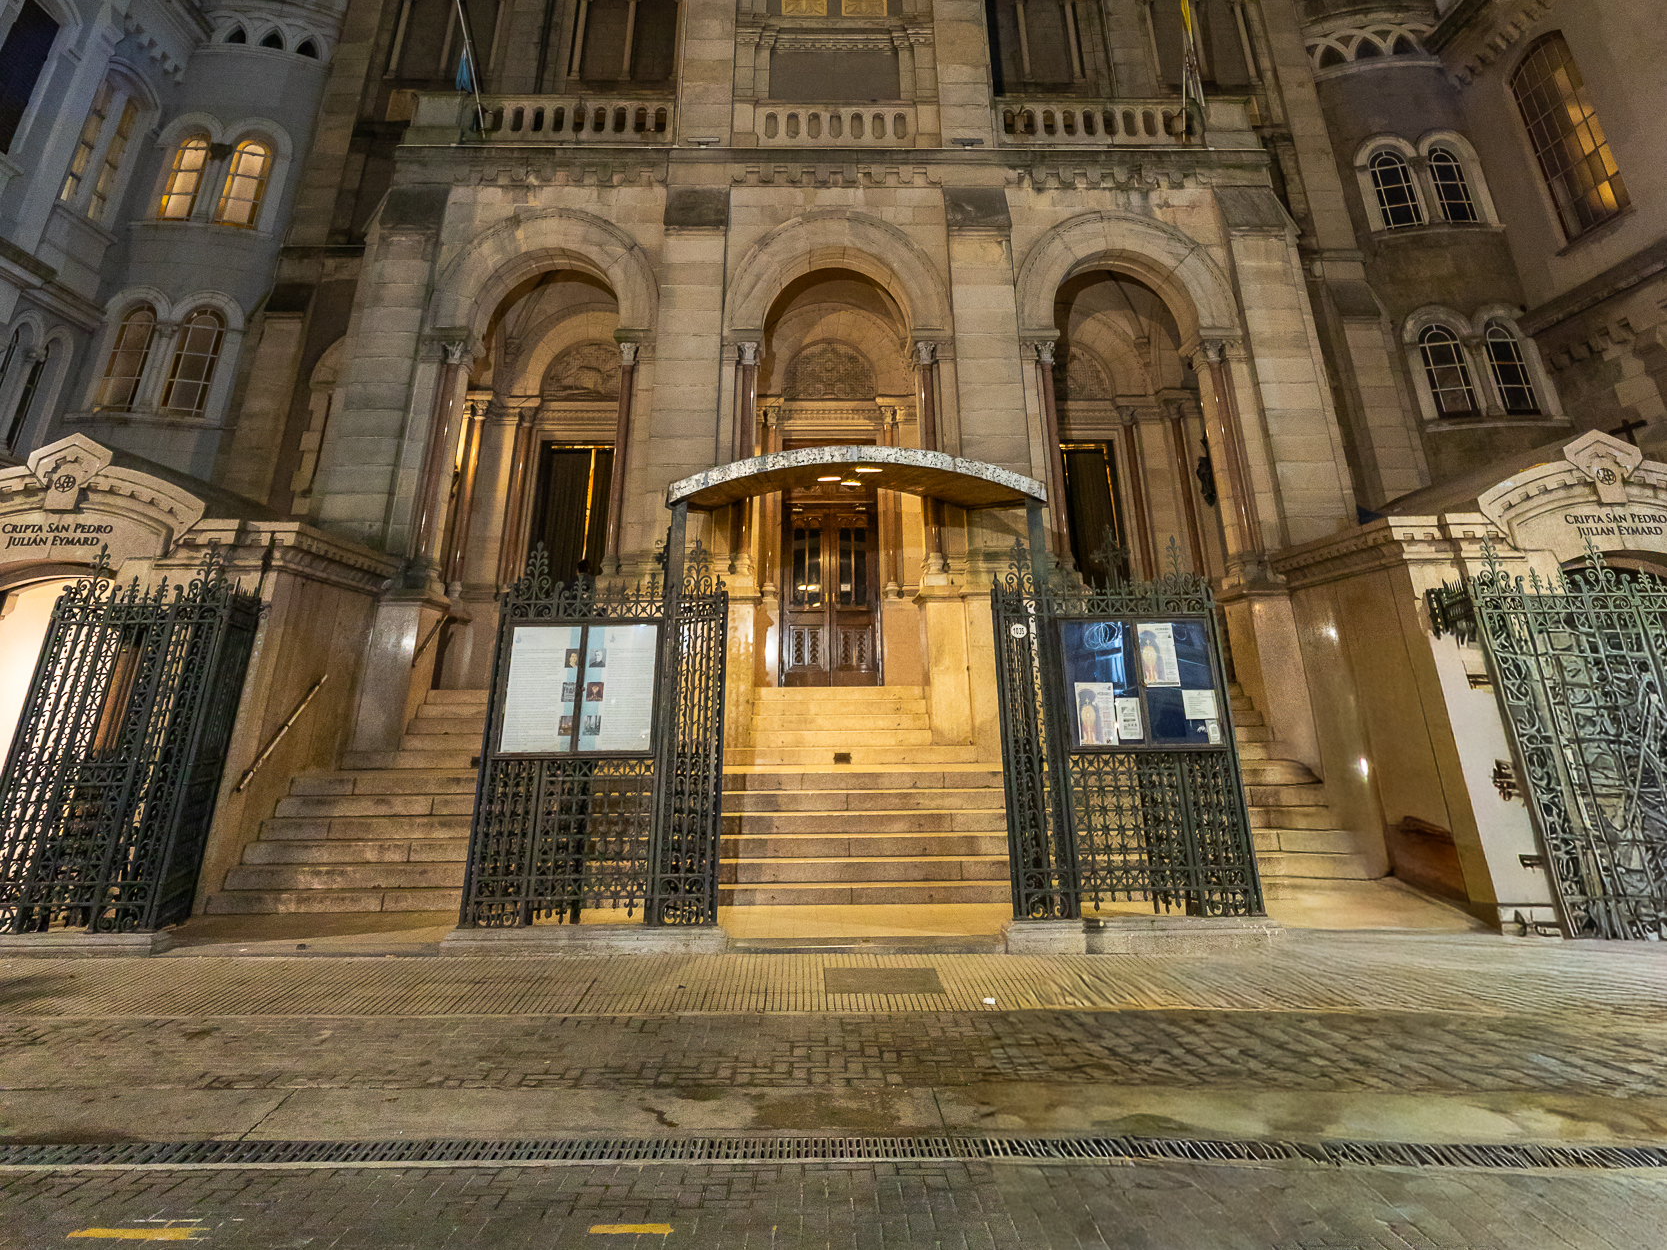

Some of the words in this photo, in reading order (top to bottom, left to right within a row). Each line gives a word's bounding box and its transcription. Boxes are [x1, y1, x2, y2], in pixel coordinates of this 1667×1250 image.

[1564, 514, 1605, 524] CRIPTA
[1606, 513, 1627, 523] SAN
[1629, 513, 1667, 523] PEDRO
[2, 523, 42, 534] CRIPTA
[46, 523, 70, 533] SAN
[73, 523, 113, 534] PEDRO
[1617, 525, 1663, 536] EYMARD
[5, 534, 48, 549] JULIÁN
[51, 535, 100, 546] EYMARD
[1013, 627, 1025, 635] 1035
